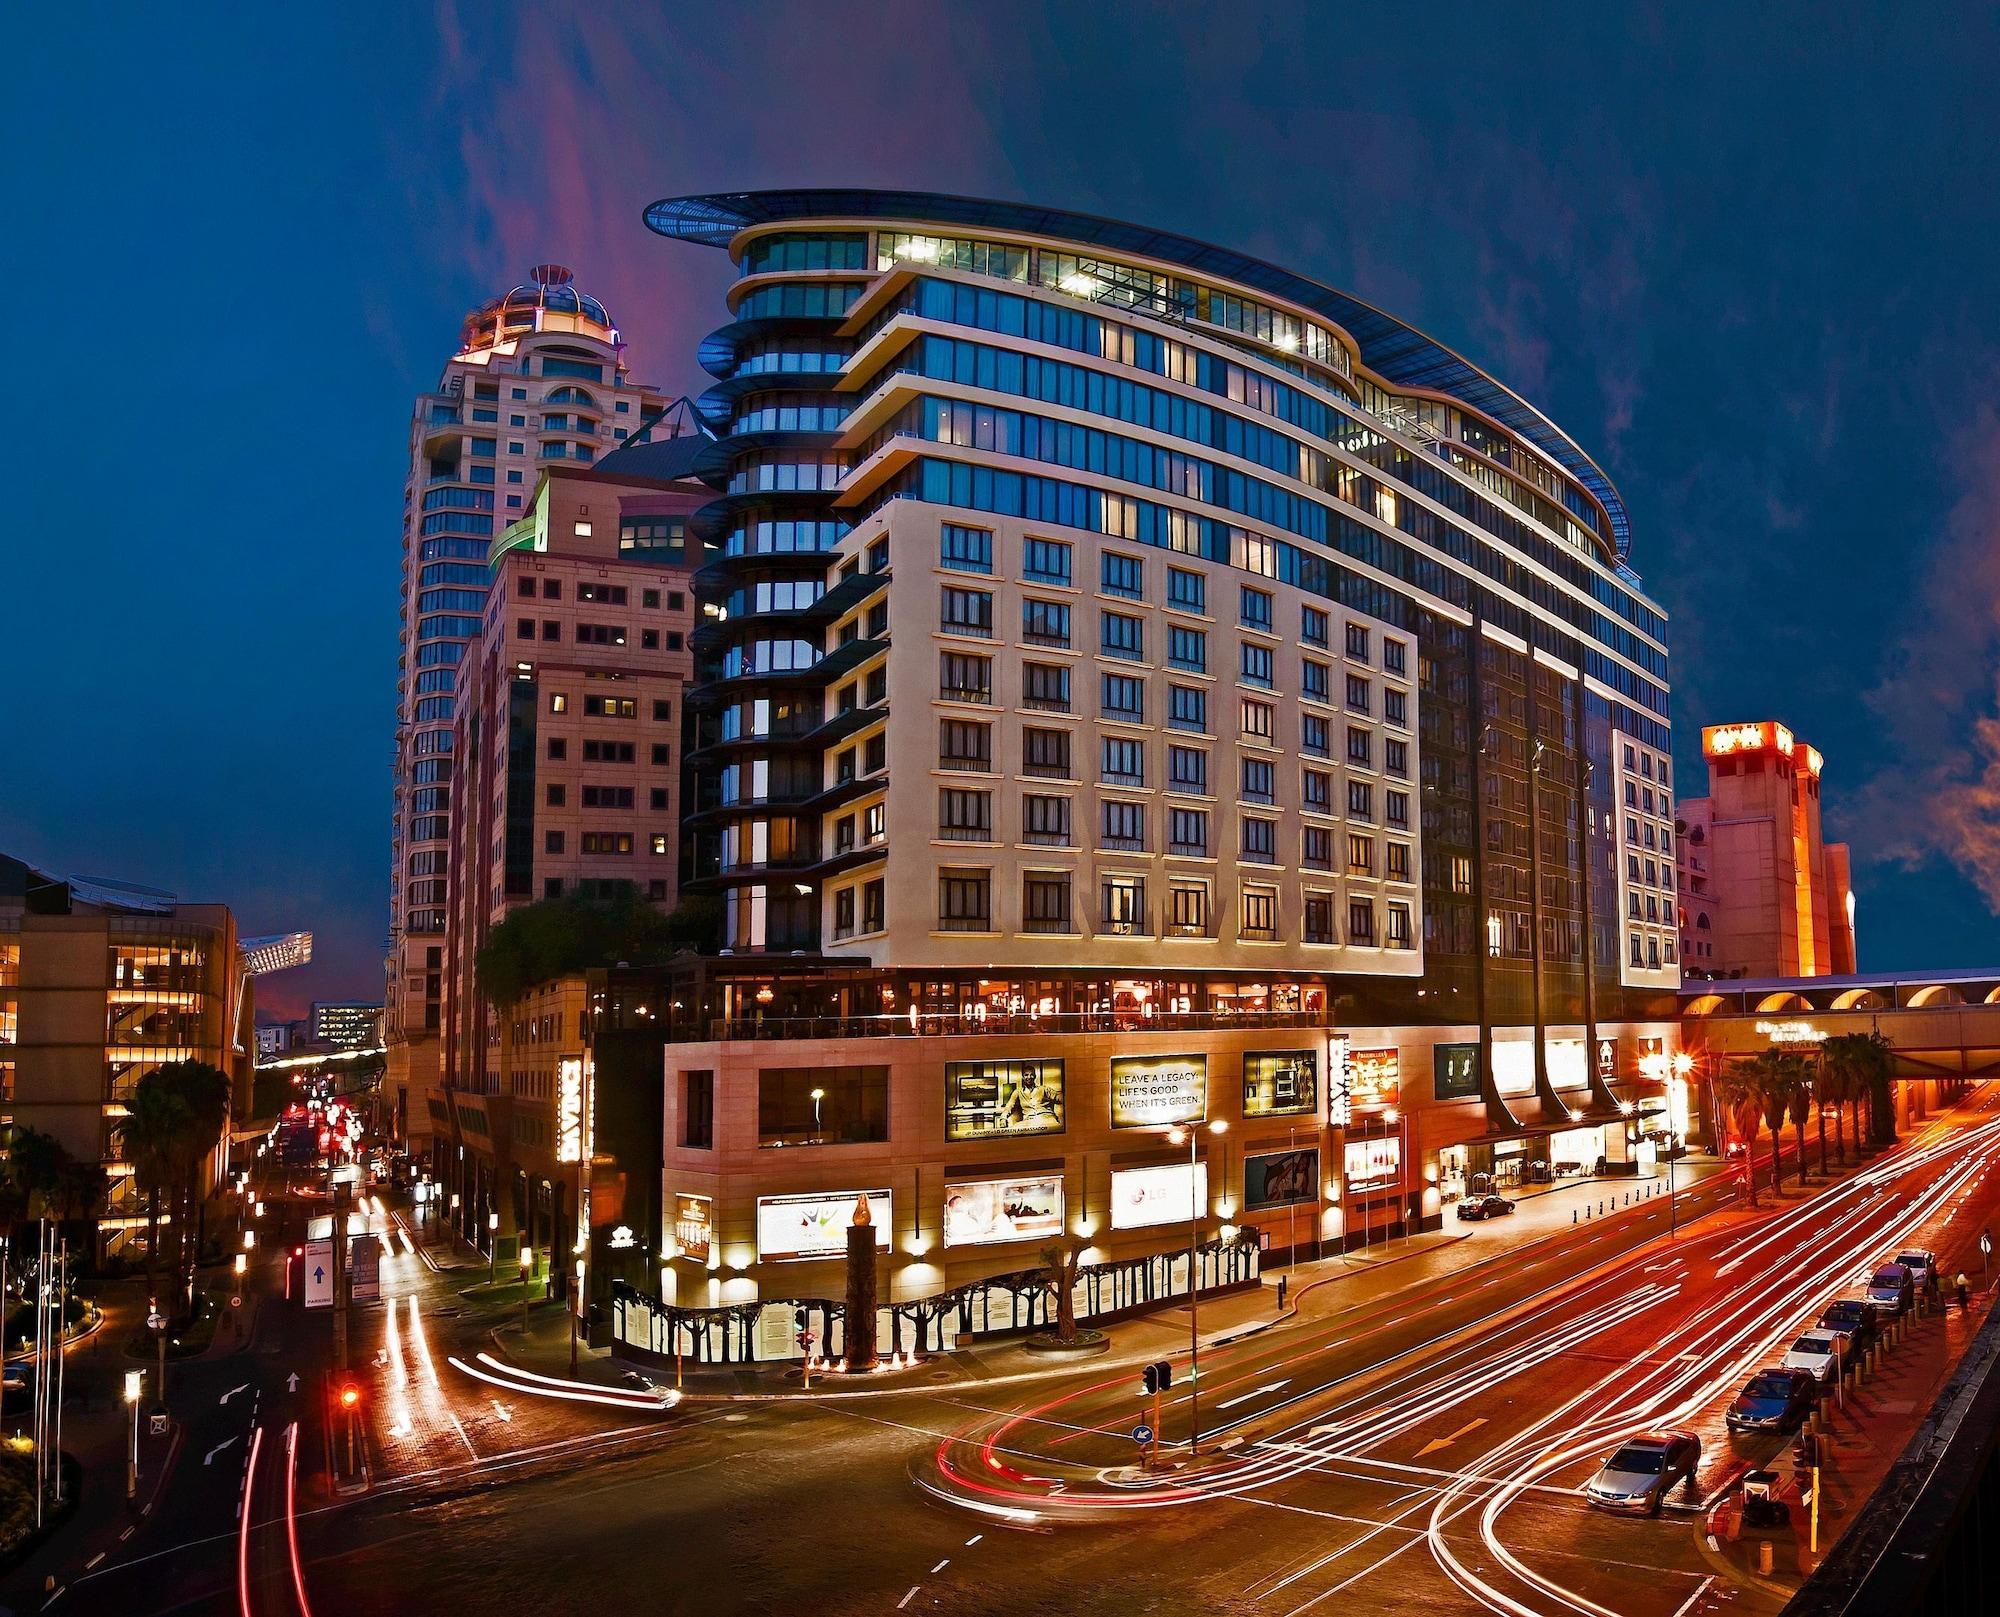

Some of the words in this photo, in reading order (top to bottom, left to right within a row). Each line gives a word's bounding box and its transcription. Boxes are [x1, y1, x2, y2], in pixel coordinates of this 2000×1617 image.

[1119, 1074, 1150, 1085] LEAVE
[1152, 1074, 1159, 1083] A
[1119, 1087, 1148, 1097] LIFE'S
[1150, 1085, 1179, 1095] GOOD
[1119, 1099, 1148, 1109] WHEN
[1150, 1098, 1167, 1108] IT'S
[1149, 1188, 1167, 1201] LG
